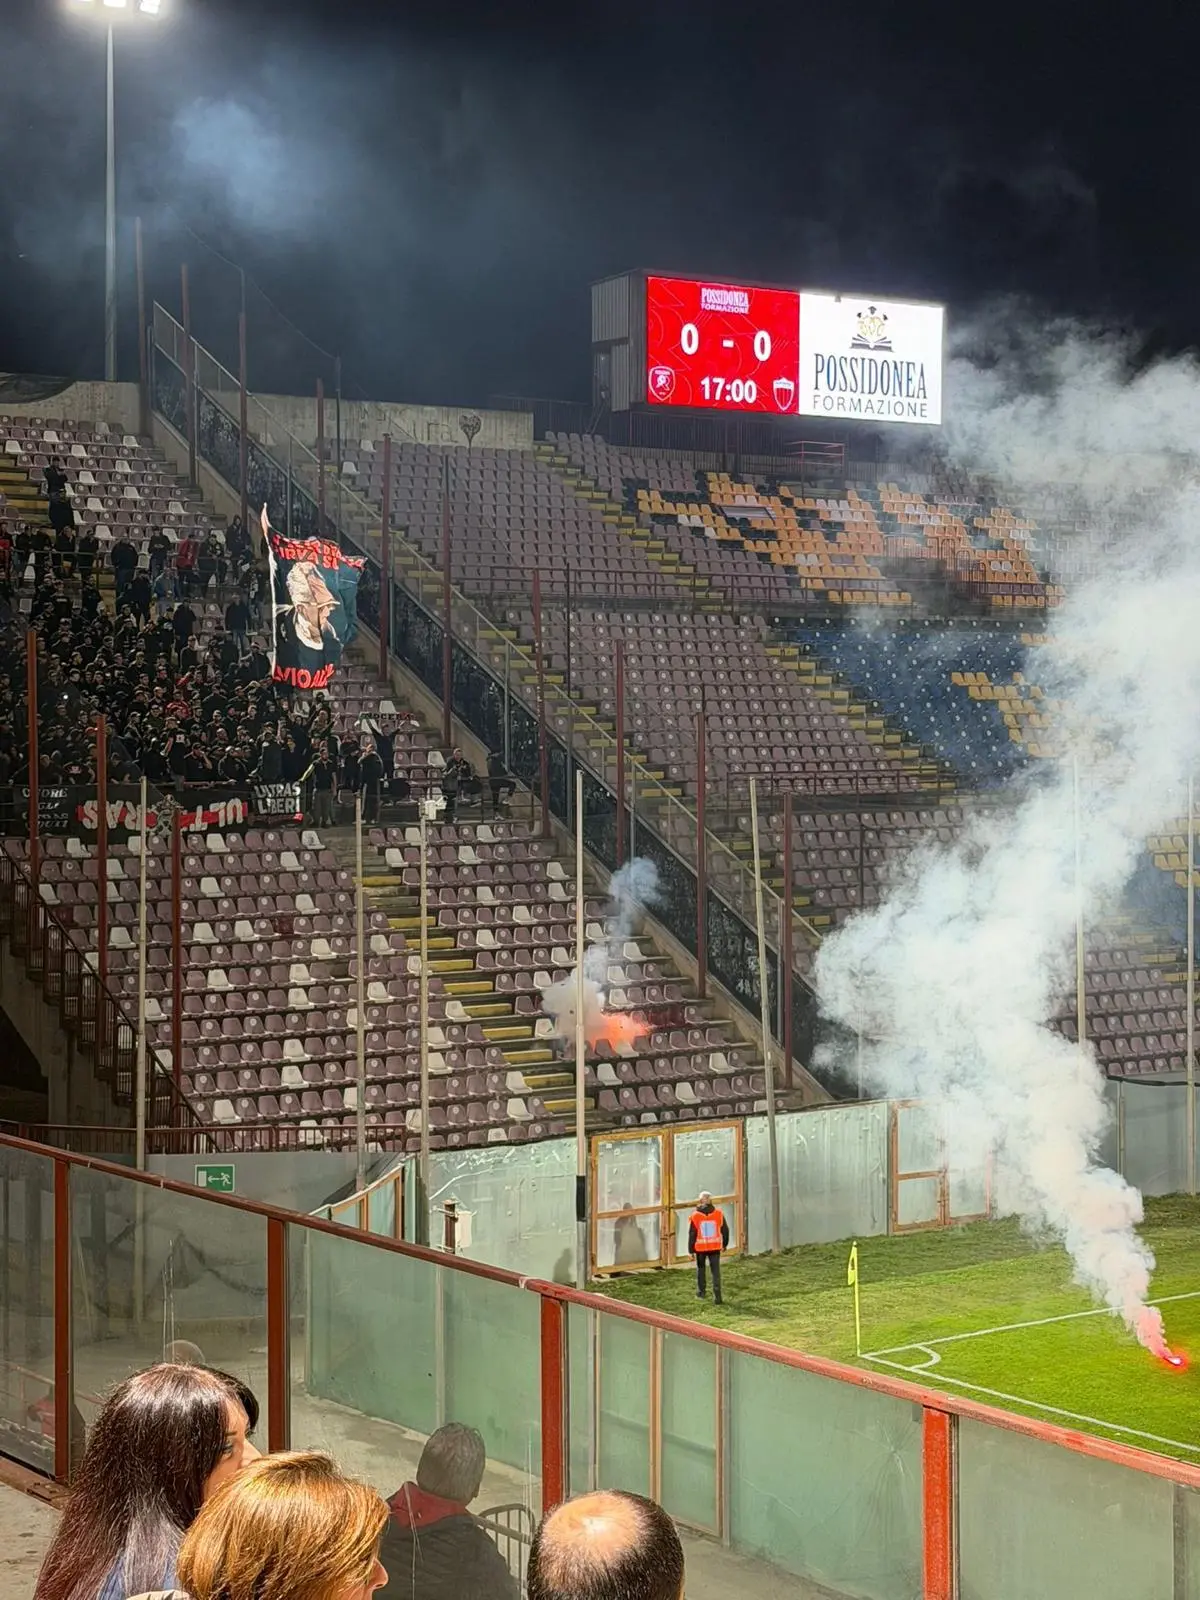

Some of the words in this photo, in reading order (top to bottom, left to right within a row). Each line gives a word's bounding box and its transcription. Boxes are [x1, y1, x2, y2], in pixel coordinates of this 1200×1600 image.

[701, 288, 748, 307] POSSIDONEA
[681, 323, 699, 355] 0
[754, 330, 772, 362] 0
[701, 376, 757, 404] 17:00
[813, 353, 928, 399] POSSIDONEA
[813, 394, 928, 418] FORMAZIONE
